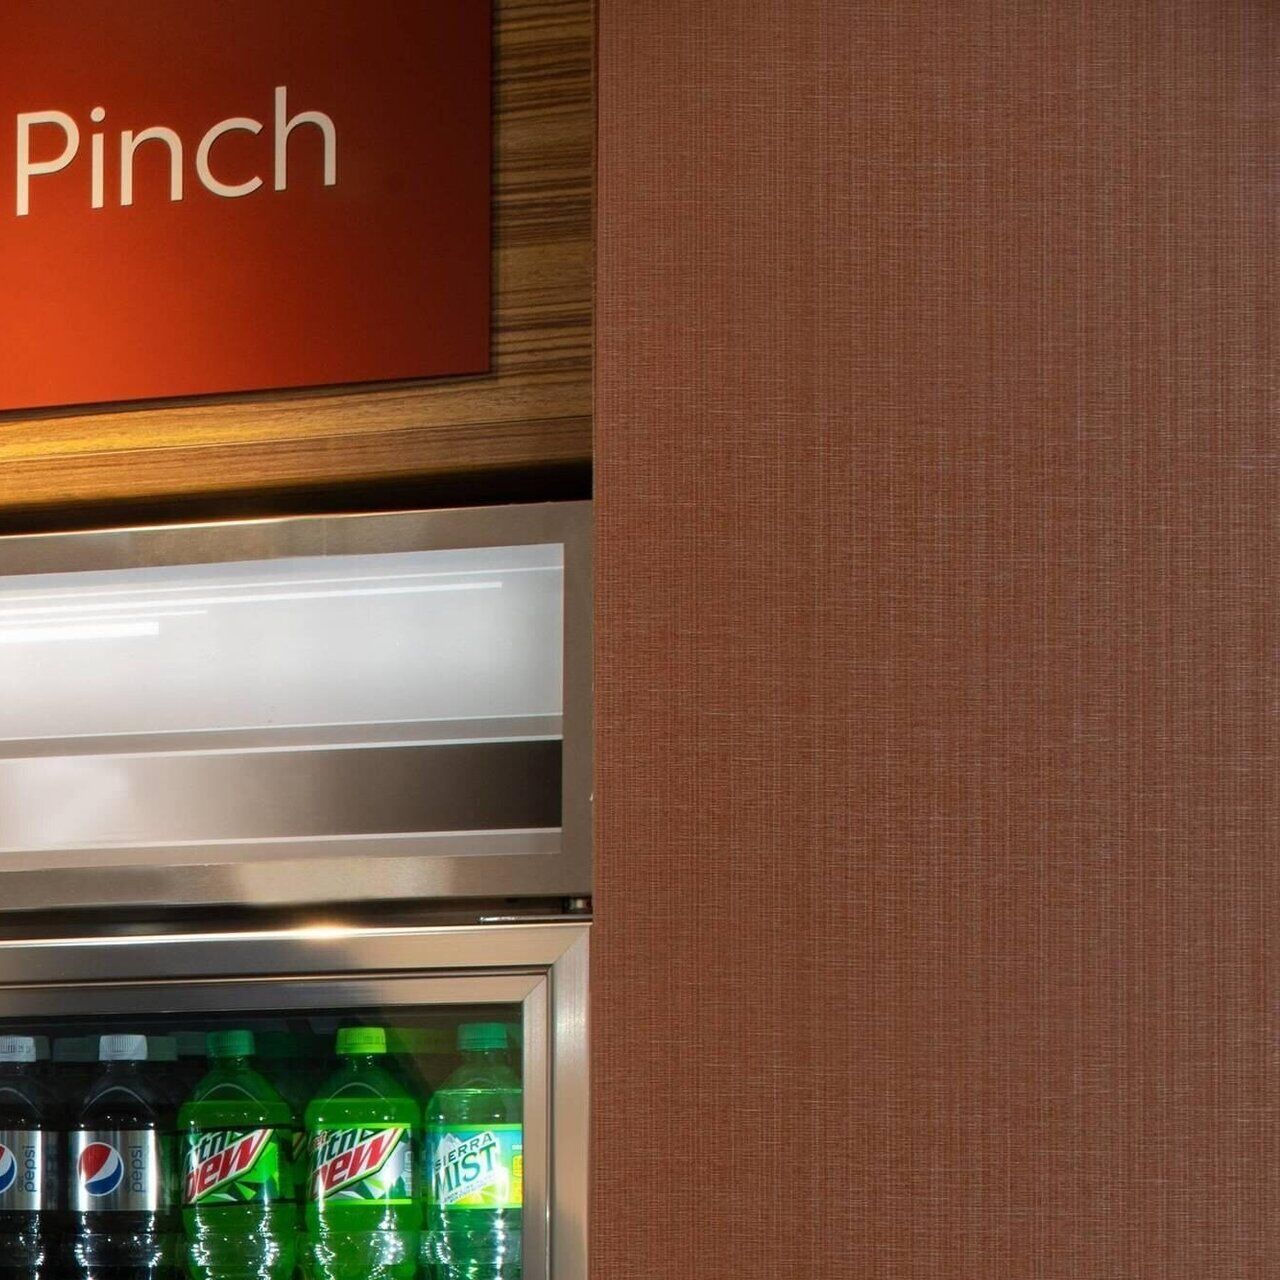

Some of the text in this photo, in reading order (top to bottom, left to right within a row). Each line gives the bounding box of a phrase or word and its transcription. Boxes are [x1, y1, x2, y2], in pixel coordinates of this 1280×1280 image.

[16, 85, 338, 217] Pinch
[24, 1145, 38, 1194] pepsi
[135, 1145, 146, 1194] pepsi
[435, 1131, 493, 1172] SIERRA
[435, 1141, 497, 1197] MIST
